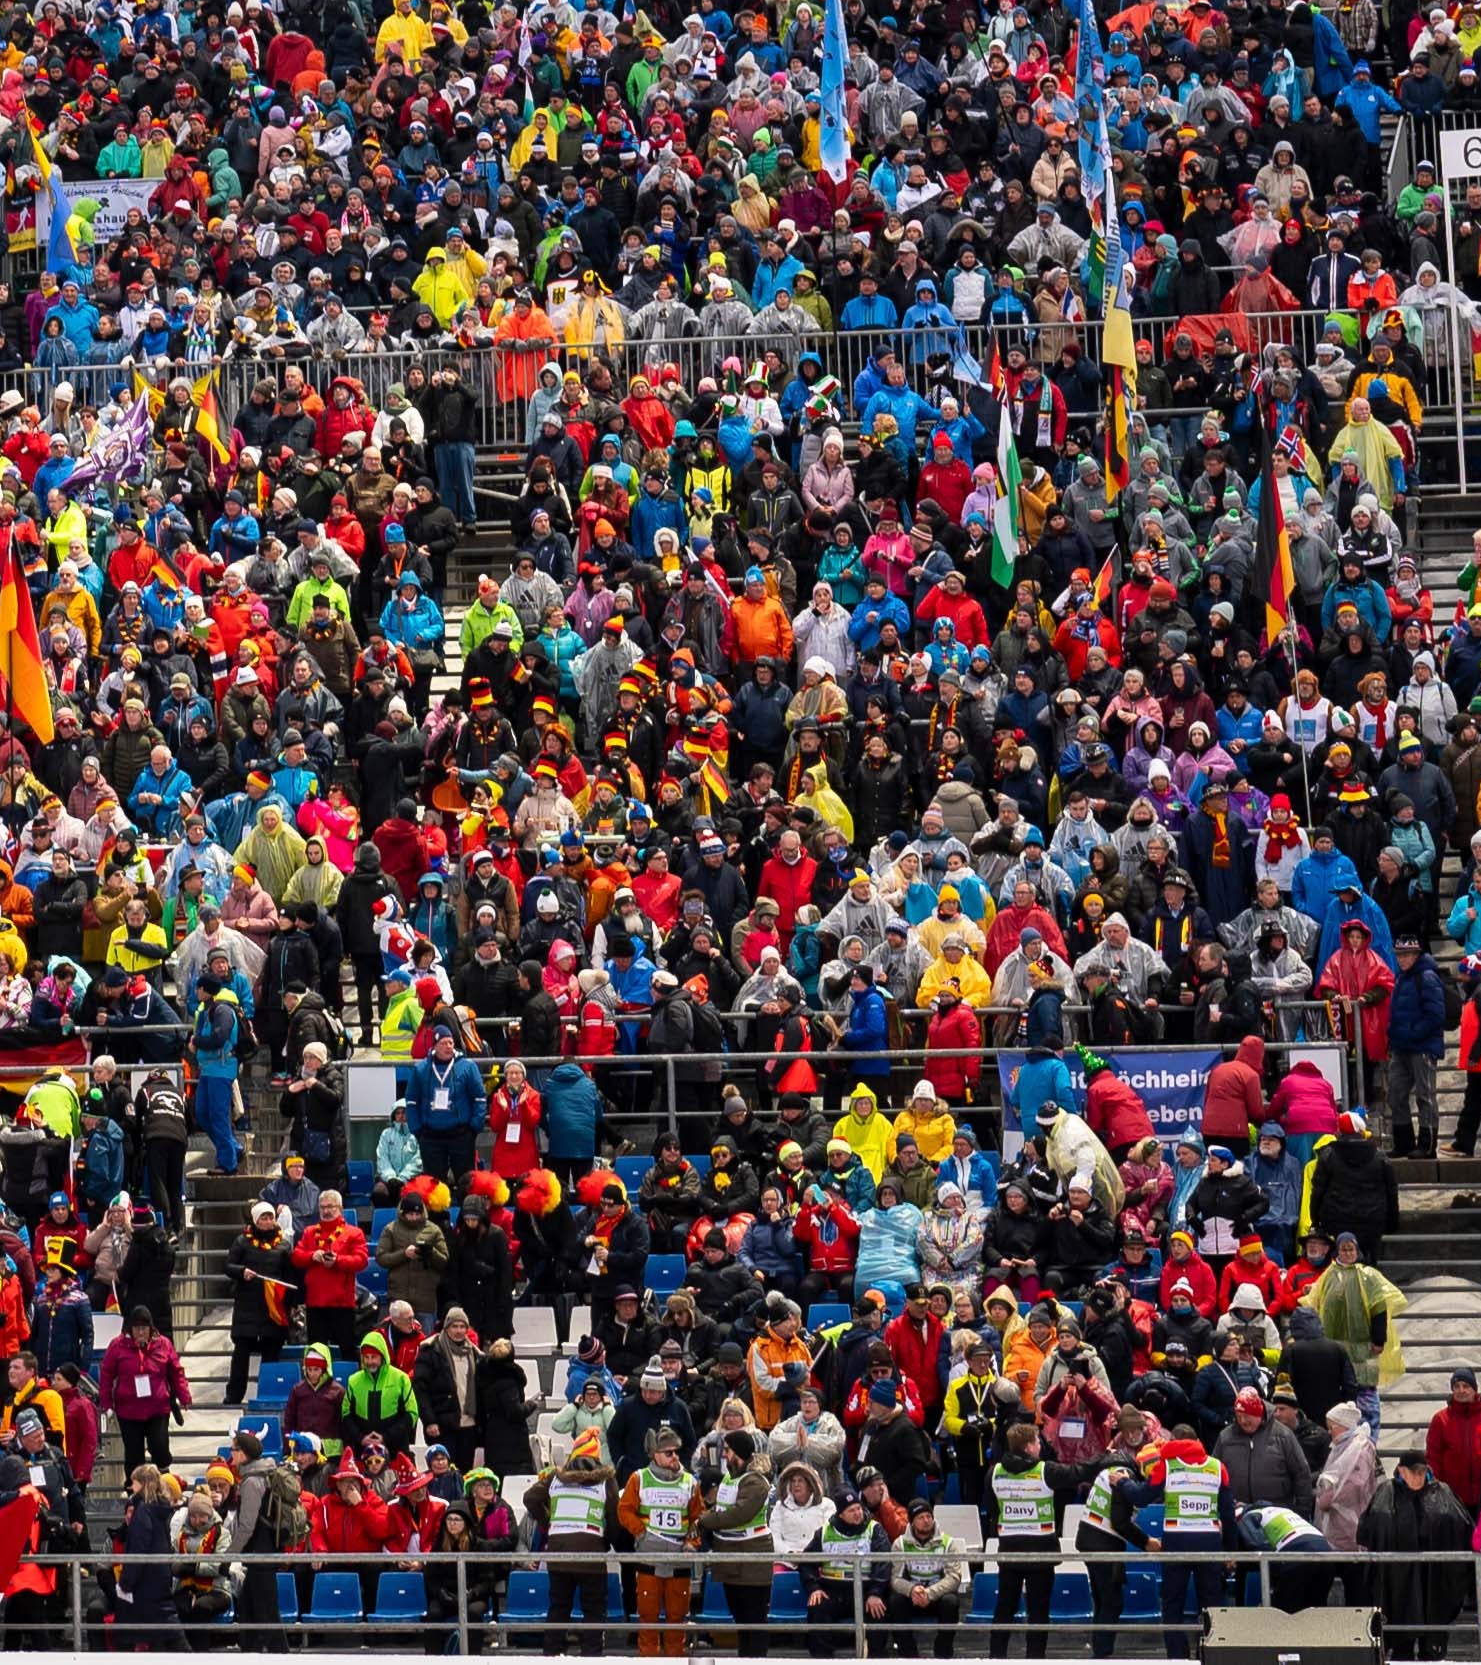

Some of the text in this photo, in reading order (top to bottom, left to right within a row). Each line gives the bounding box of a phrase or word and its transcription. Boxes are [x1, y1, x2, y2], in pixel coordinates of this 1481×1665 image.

[1146, 1105, 1204, 1124] eben
[1003, 1505, 1035, 1518] Dany
[1180, 1498, 1210, 1511] Sepp
[655, 1512, 677, 1528] 15
